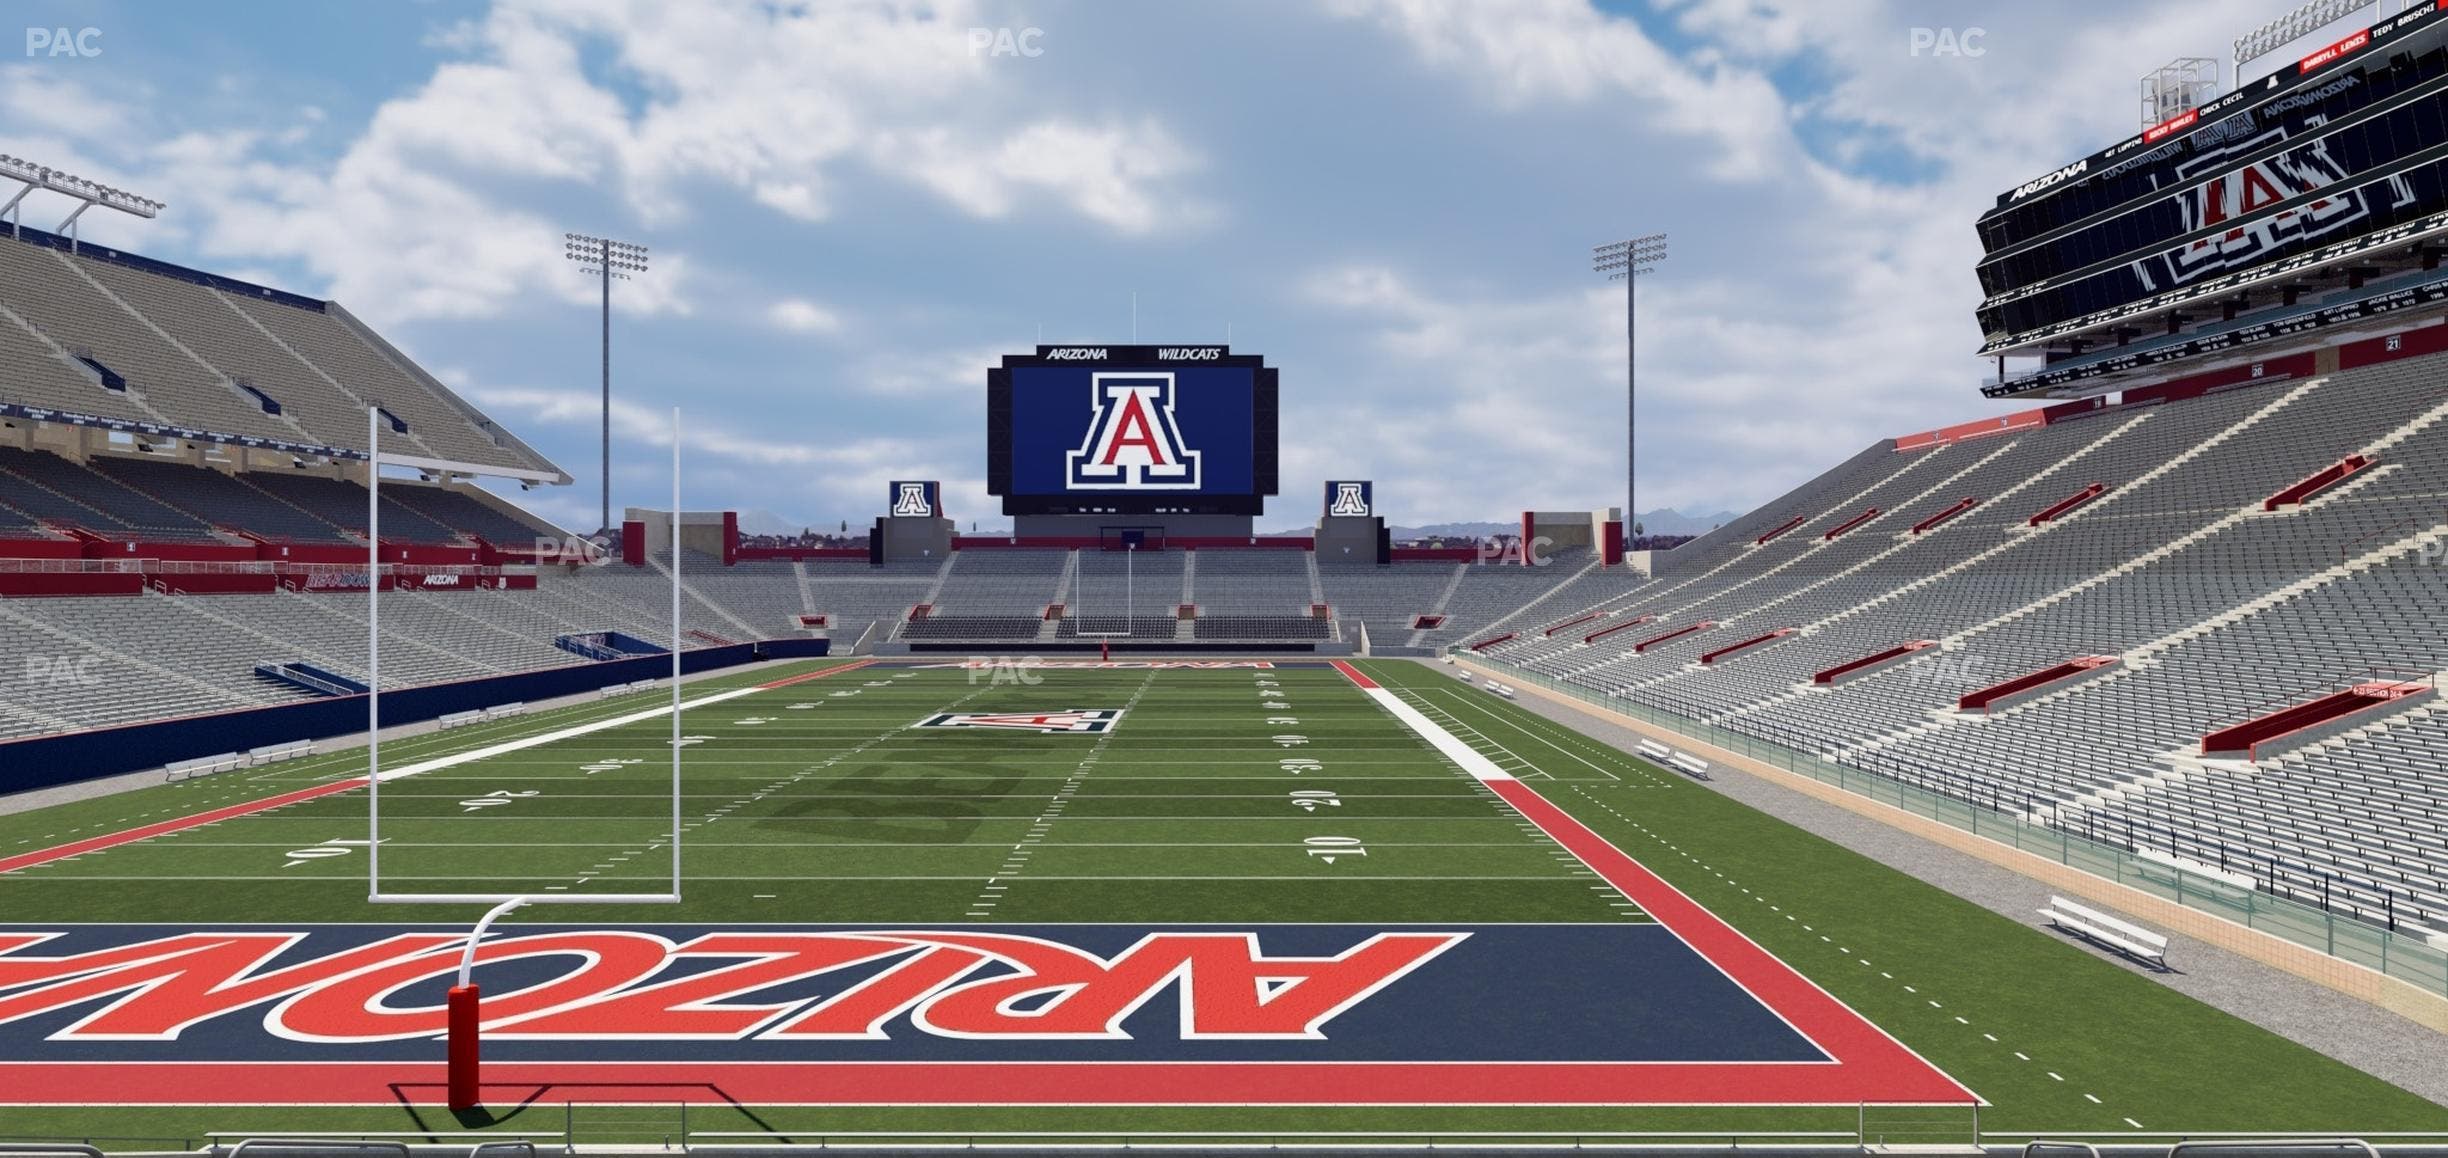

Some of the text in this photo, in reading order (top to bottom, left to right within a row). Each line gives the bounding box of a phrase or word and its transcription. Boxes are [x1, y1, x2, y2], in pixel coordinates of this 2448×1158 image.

[2372, 2, 2435, 38] TEDY BRUSCHI
[2008, 159, 2087, 203] ARIZONA
[1046, 347, 1221, 361] ARIZONA WILDCATS
[2387, 339, 2399, 350] 21
[1066, 372, 1201, 490] A
[893, 483, 932, 517] A
[1330, 483, 1369, 517] A
[423, 574, 459, 585] ARIZONA
[1279, 758, 1323, 771] 30
[458, 790, 541, 807] 20
[1288, 790, 1342, 807] 20
[1303, 836, 1367, 857] 10
[0, 931, 1475, 1042] ARIZON
